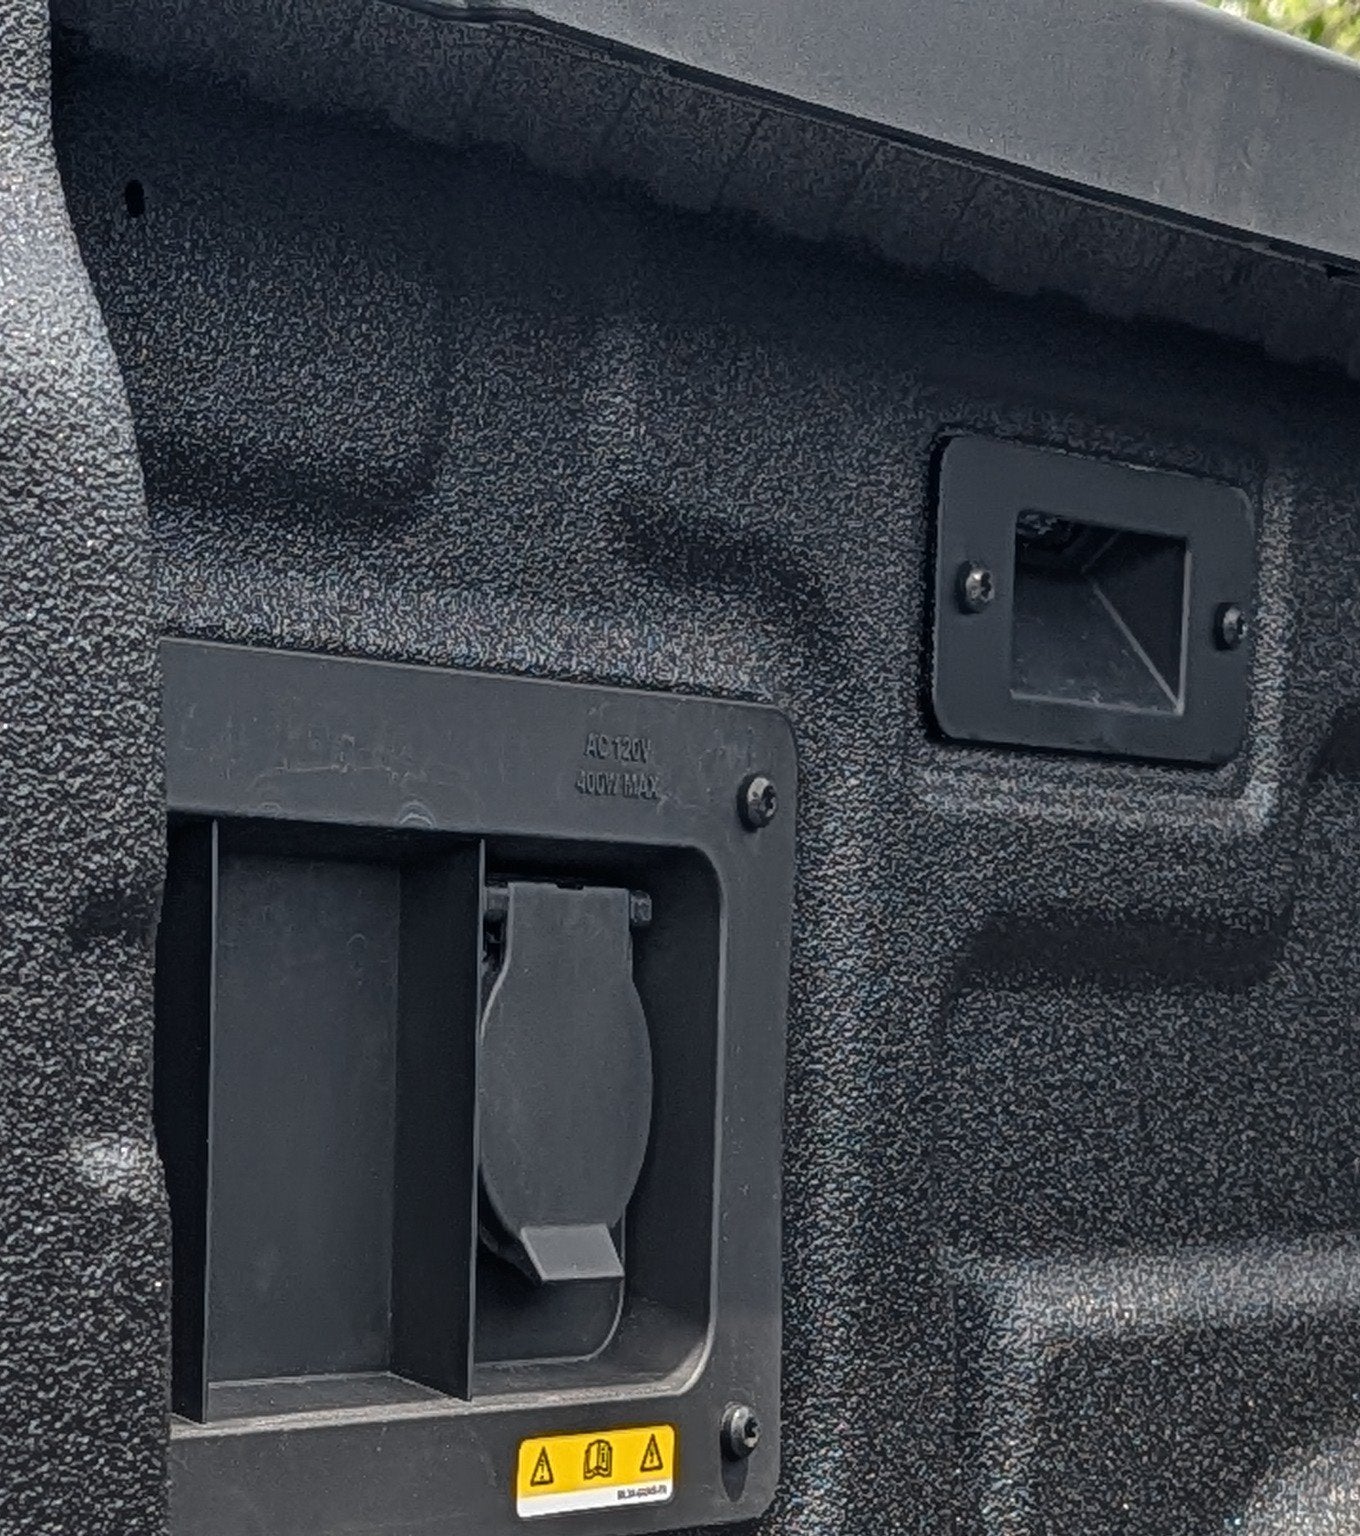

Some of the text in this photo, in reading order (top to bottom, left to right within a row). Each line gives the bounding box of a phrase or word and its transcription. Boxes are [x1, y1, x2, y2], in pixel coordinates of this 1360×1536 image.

[582, 731, 651, 763] AC 120V
[573, 769, 659, 800] 400W MAX
